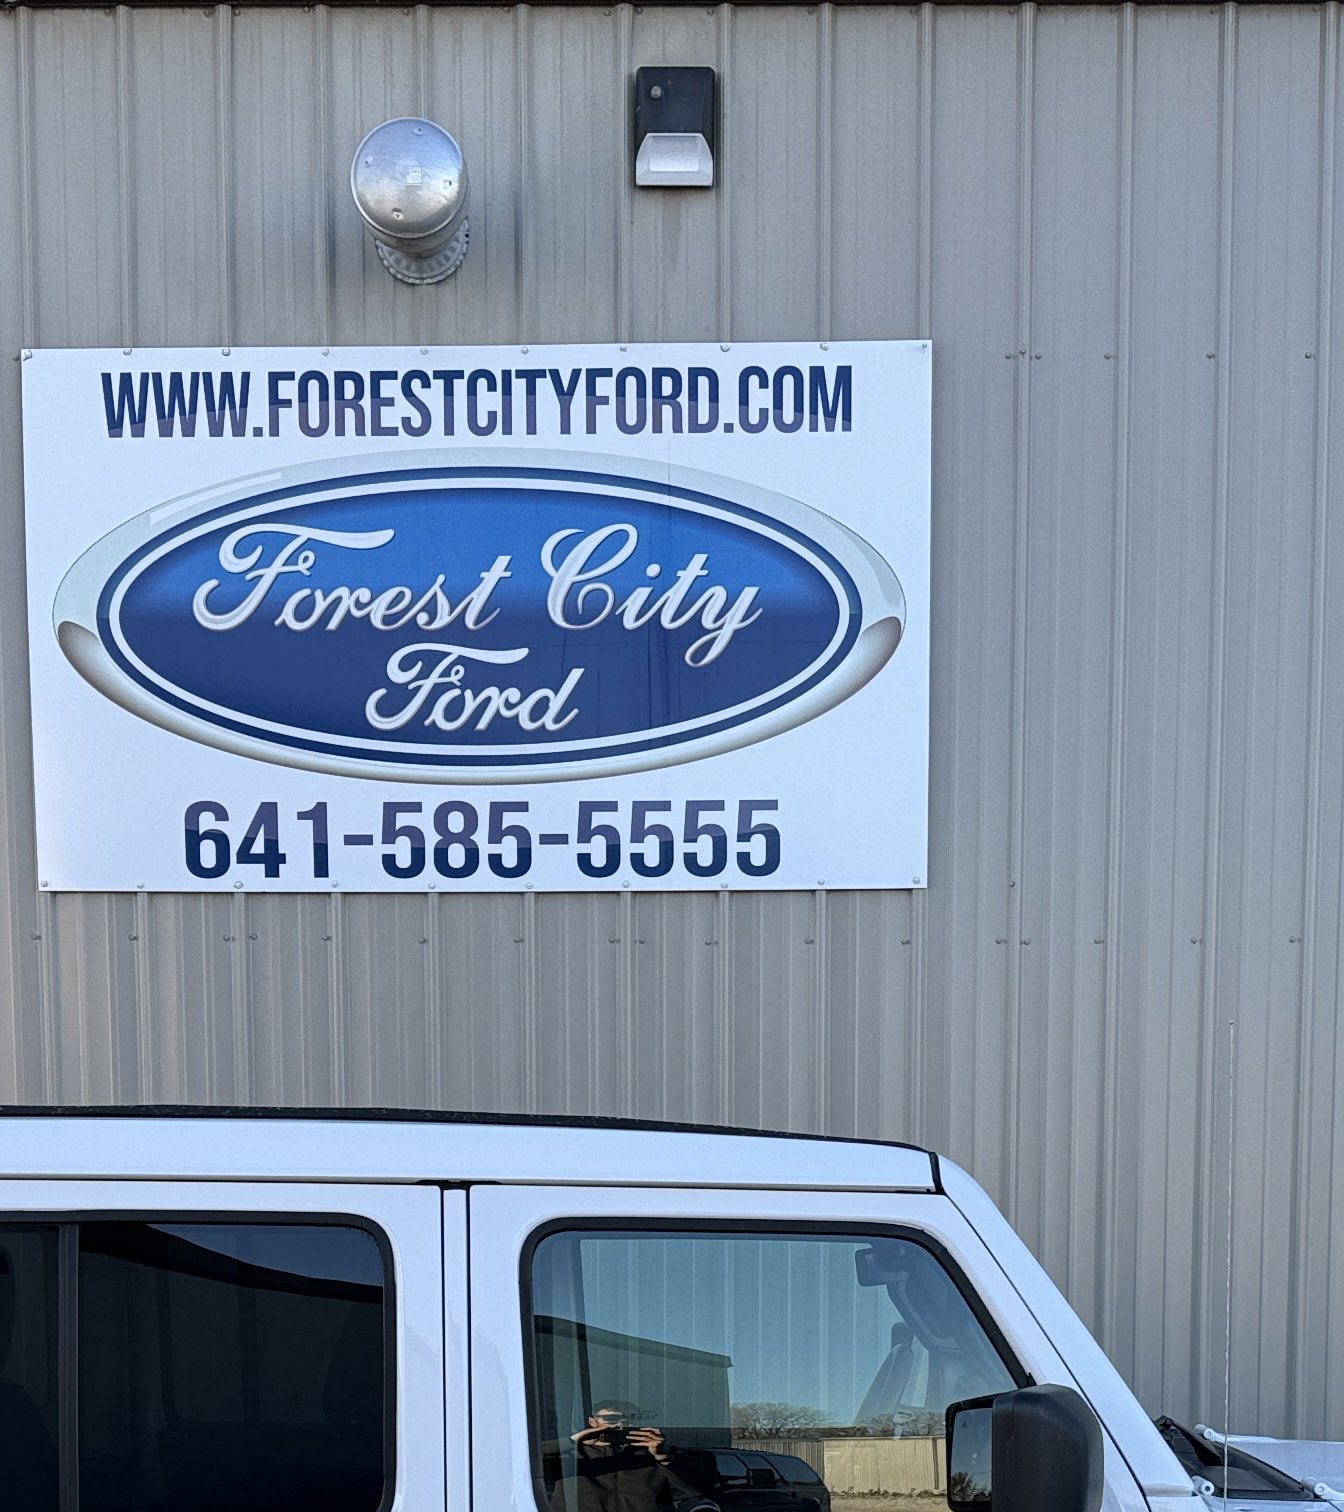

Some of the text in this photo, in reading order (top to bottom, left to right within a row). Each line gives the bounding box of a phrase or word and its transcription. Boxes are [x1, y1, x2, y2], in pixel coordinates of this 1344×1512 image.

[102, 366, 854, 440] WWW.FORESTCITYFORD.COM
[191, 522, 763, 668] Forest City
[363, 642, 585, 734] Ford
[182, 799, 782, 880] 641-585-5555
